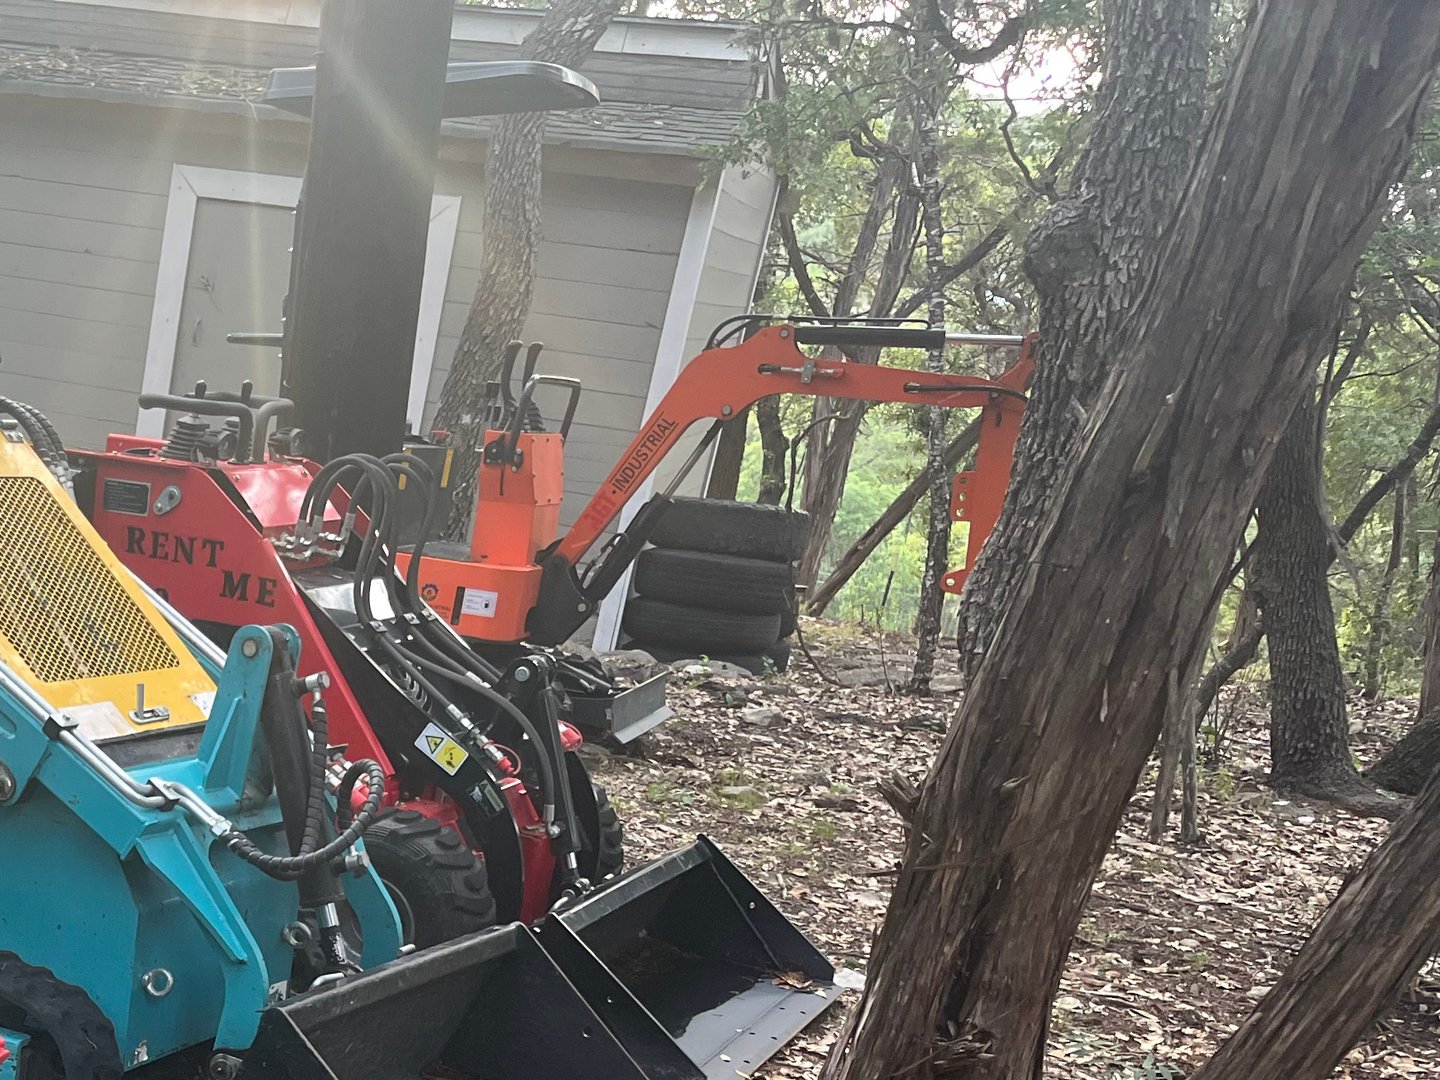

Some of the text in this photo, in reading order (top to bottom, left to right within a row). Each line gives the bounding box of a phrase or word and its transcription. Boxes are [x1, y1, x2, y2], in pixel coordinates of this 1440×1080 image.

[611, 417, 677, 492] INDUSTRIAL
[125, 526, 224, 567] RENT
[219, 570, 278, 608] ME
